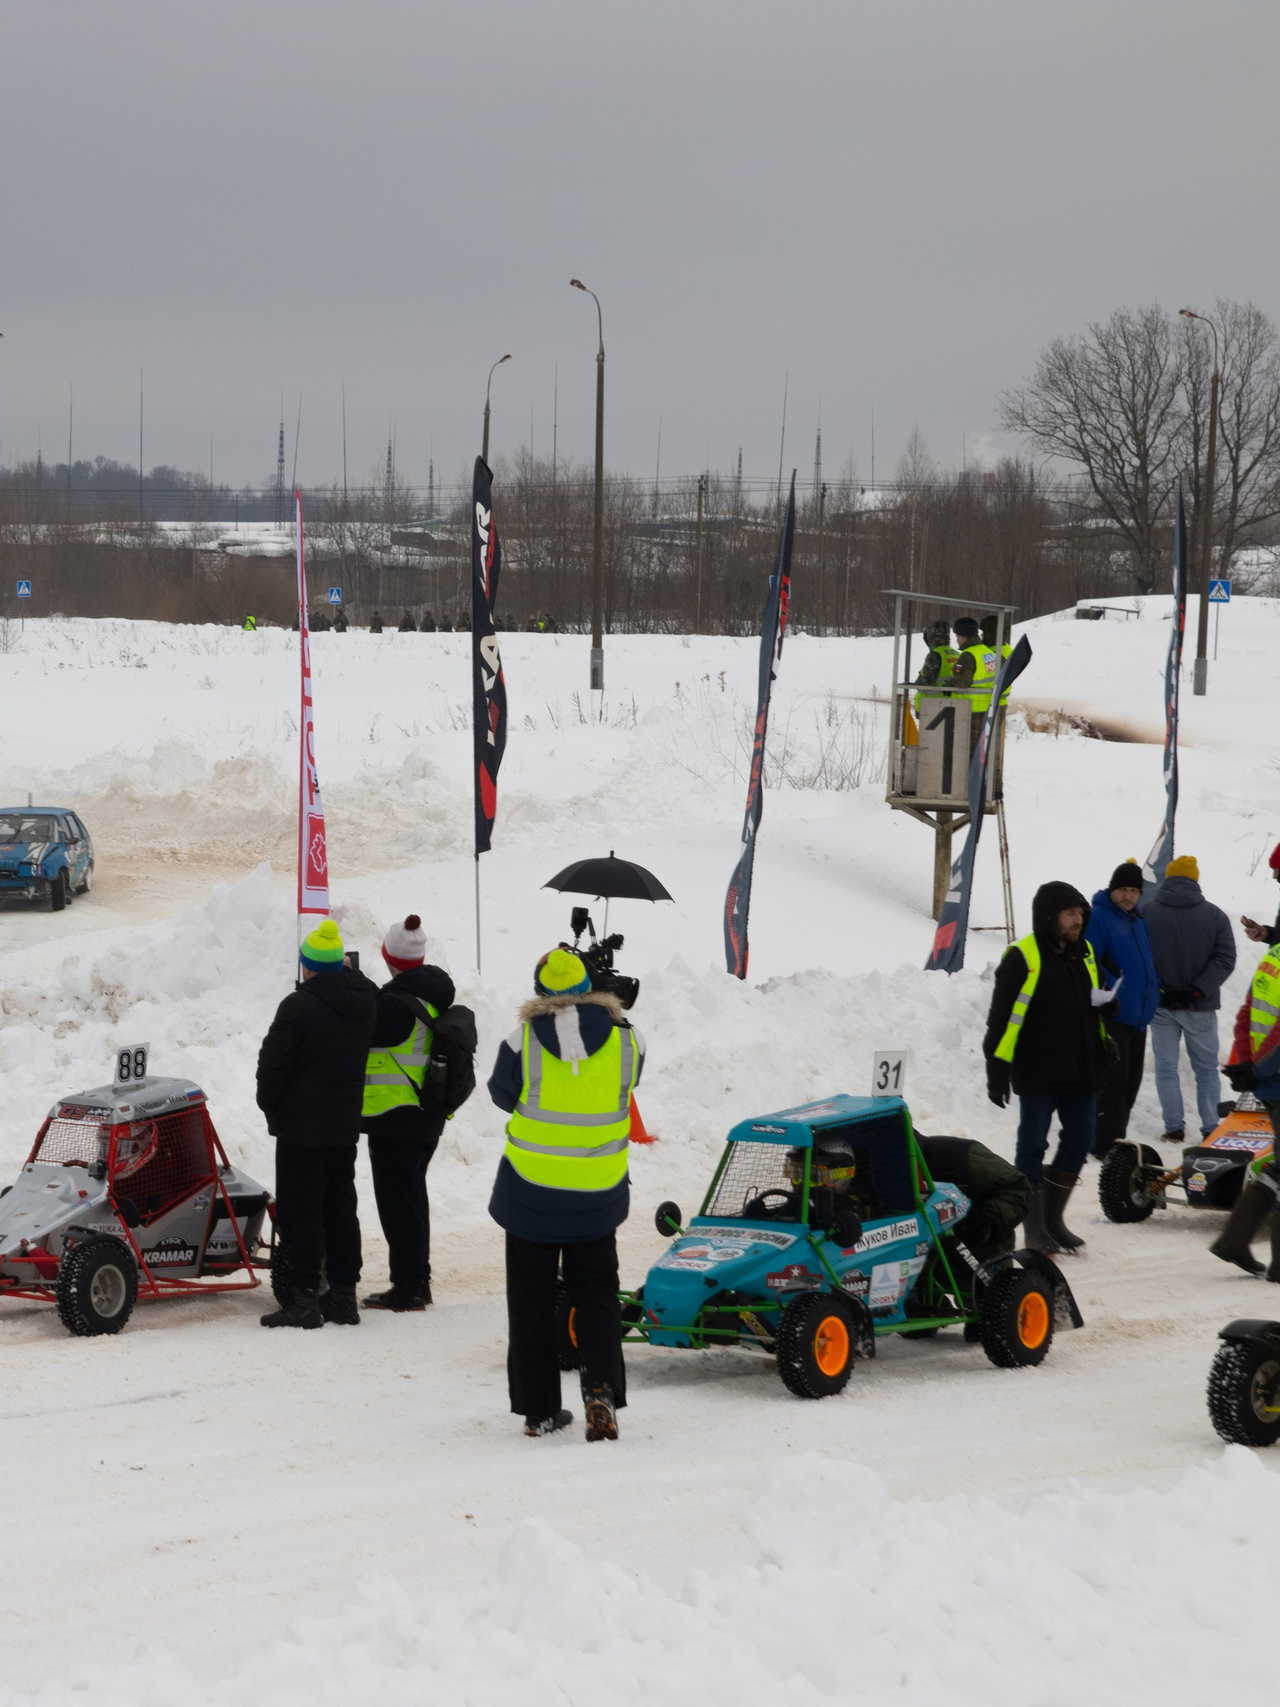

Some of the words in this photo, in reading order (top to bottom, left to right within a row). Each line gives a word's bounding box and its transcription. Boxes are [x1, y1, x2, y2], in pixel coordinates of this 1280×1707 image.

[925, 706, 955, 795] 1
[118, 1047, 147, 1082] 88
[877, 1060, 902, 1090] 31
[1213, 1138, 1270, 1149] LIQUI
[889, 1221, 917, 1239] Иван
[143, 1249, 194, 1264] KRAMAR
